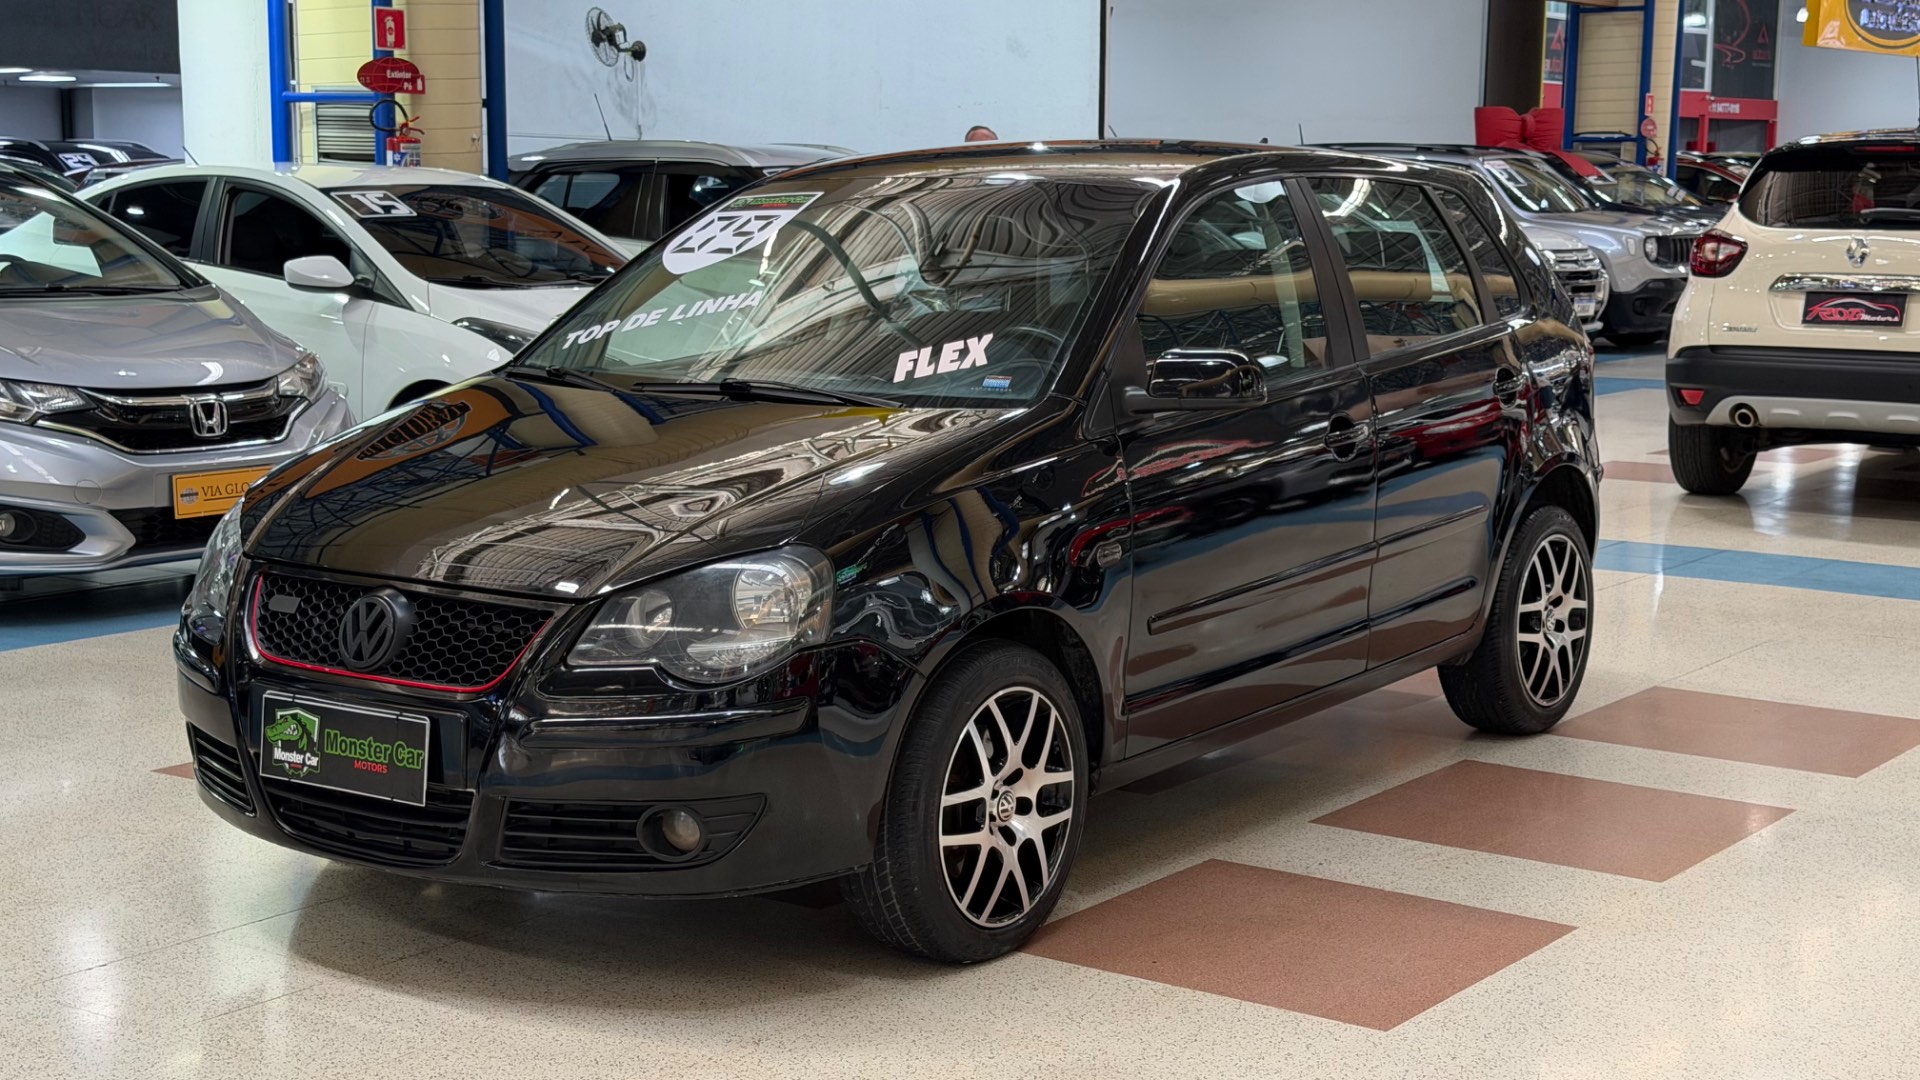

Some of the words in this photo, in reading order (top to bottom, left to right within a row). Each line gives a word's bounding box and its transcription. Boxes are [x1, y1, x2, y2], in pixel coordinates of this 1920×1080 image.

[386, 69, 412, 79] Extintor
[350, 193, 411, 215] 15
[562, 319, 621, 350] TOP
[621, 307, 668, 333] DE
[667, 290, 765, 322] LINHA
[892, 332, 994, 384] FLEX
[201, 484, 222, 497] VIA
[274, 746, 304, 764] Monster
[305, 752, 319, 767] Car
[324, 729, 392, 763] Monster
[393, 741, 424, 769] Car
[354, 760, 388, 774] MOTORS
